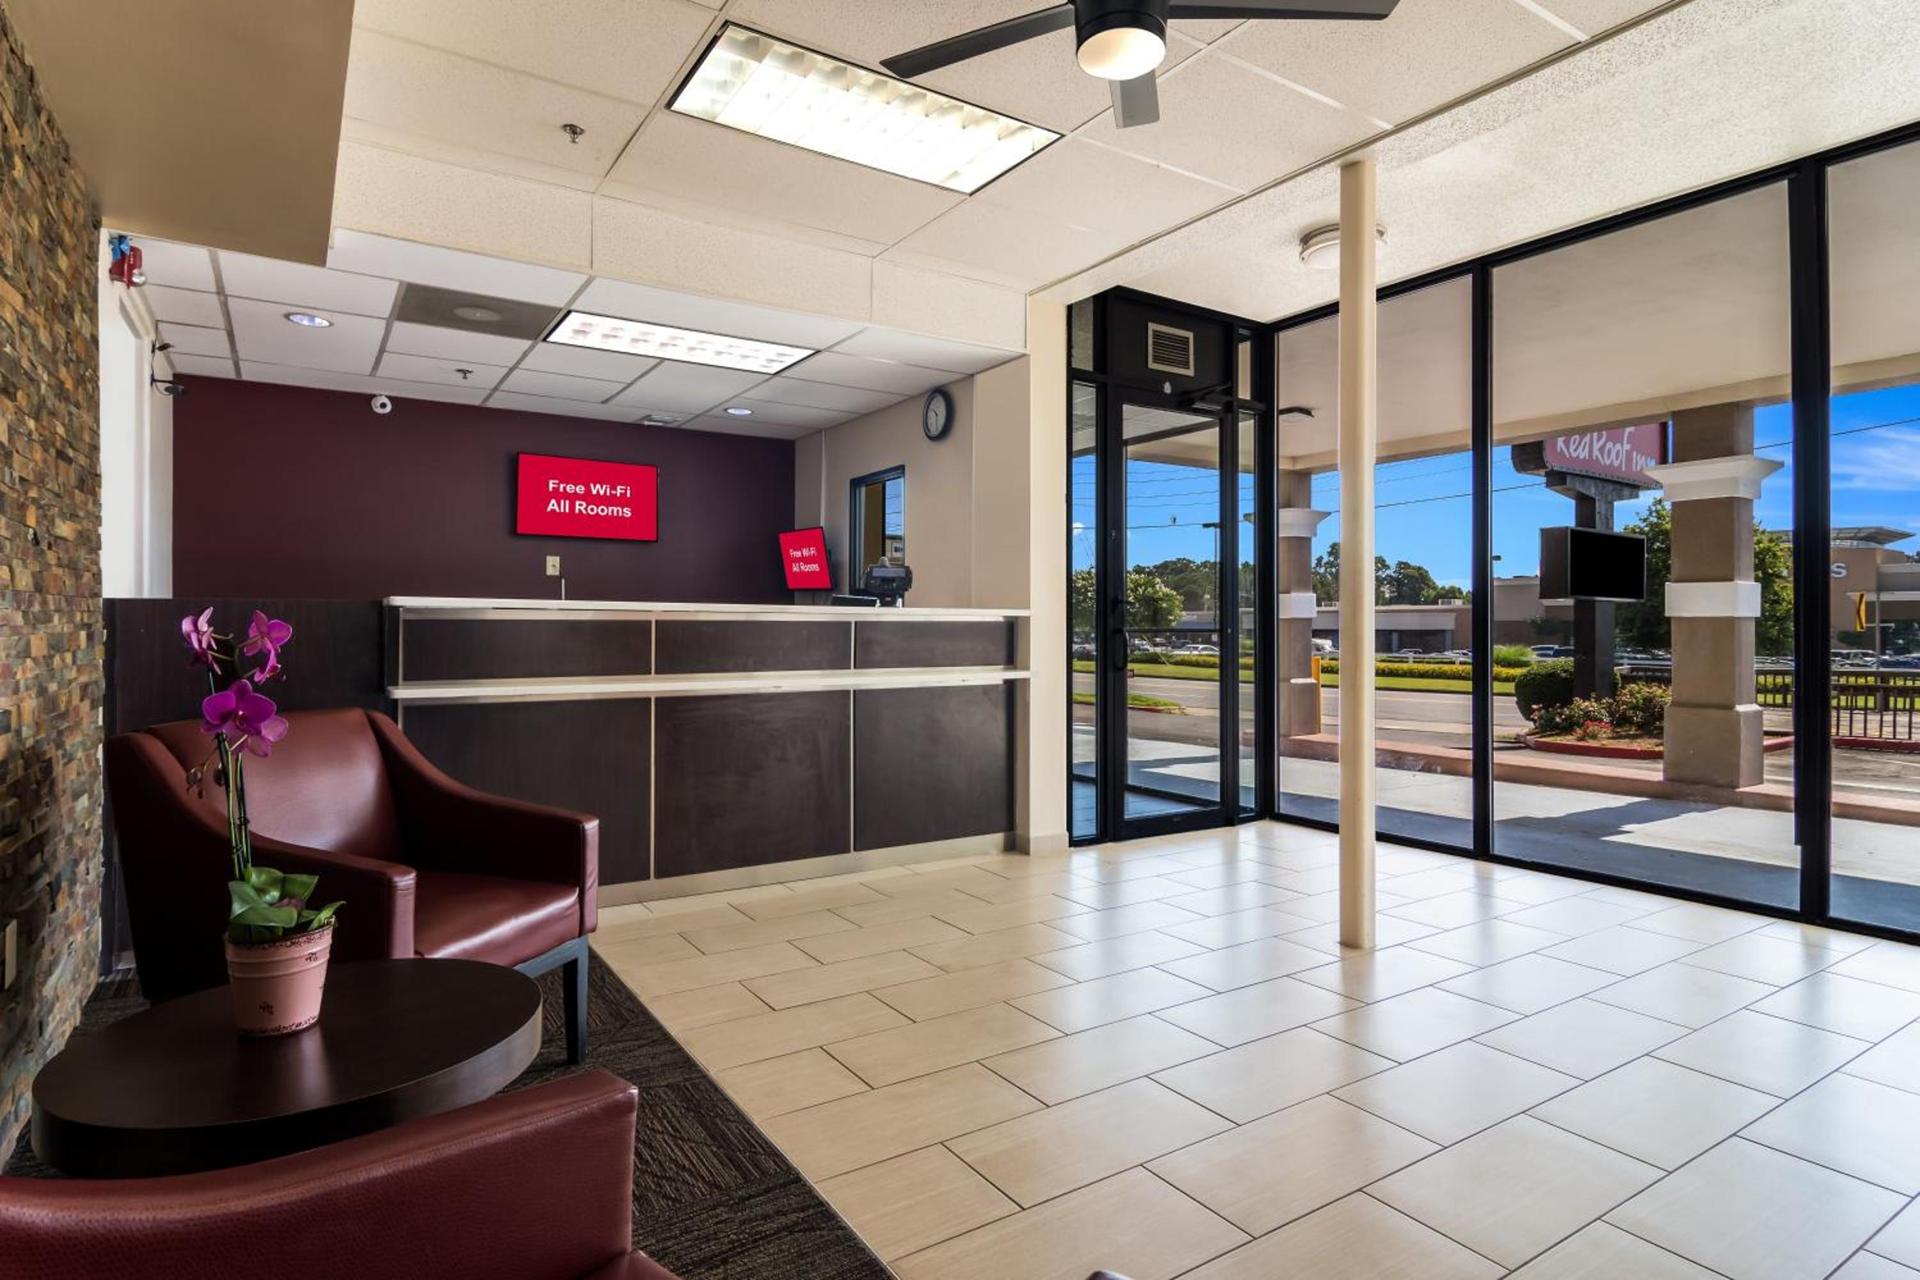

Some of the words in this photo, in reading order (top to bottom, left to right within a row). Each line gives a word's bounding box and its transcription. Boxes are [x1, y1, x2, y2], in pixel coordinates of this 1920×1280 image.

[548, 479, 585, 494] Free
[589, 482, 631, 498] Wi-Fi
[546, 498, 569, 513] All
[575, 500, 632, 518] Rooms
